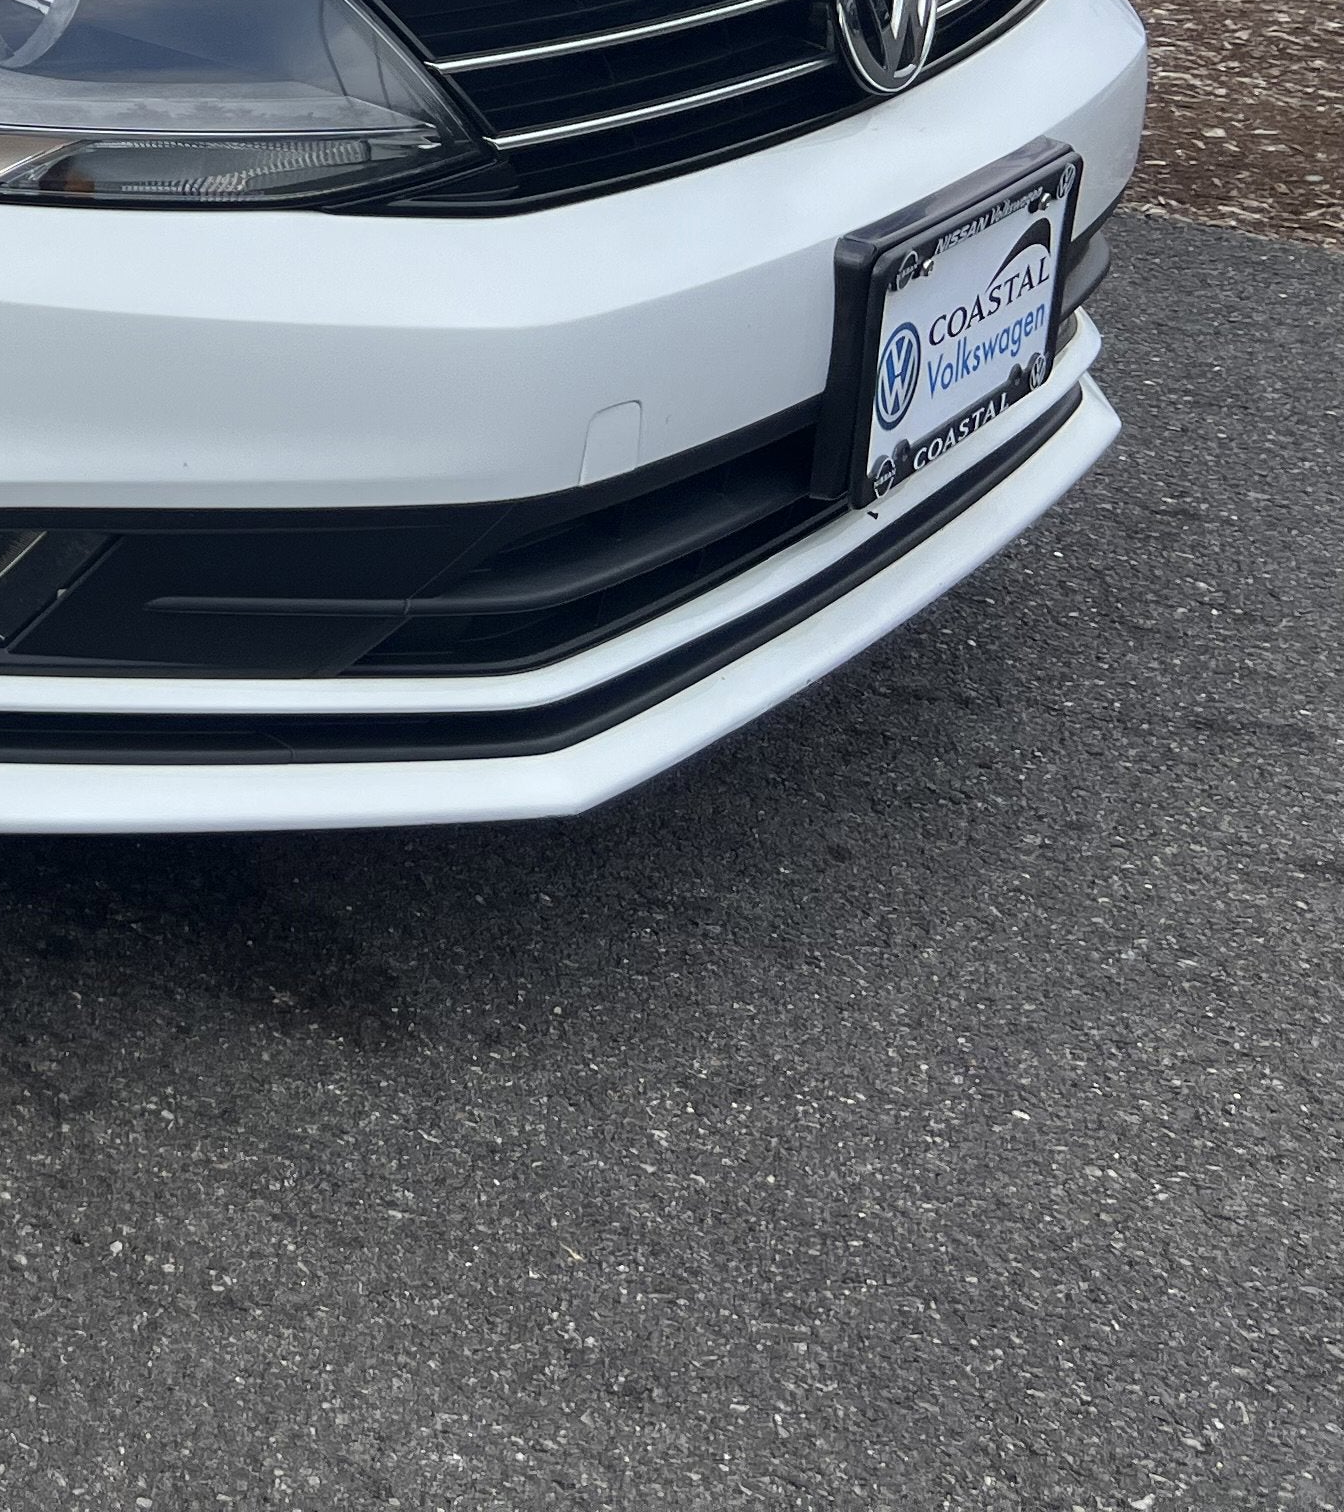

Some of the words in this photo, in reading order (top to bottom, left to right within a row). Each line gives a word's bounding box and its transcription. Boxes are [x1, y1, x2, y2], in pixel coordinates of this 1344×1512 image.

[933, 214, 990, 255] NISSAN
[928, 255, 1051, 347] COASTAL
[926, 302, 1046, 399] Volkswagen
[912, 392, 1011, 472] COASTAL
